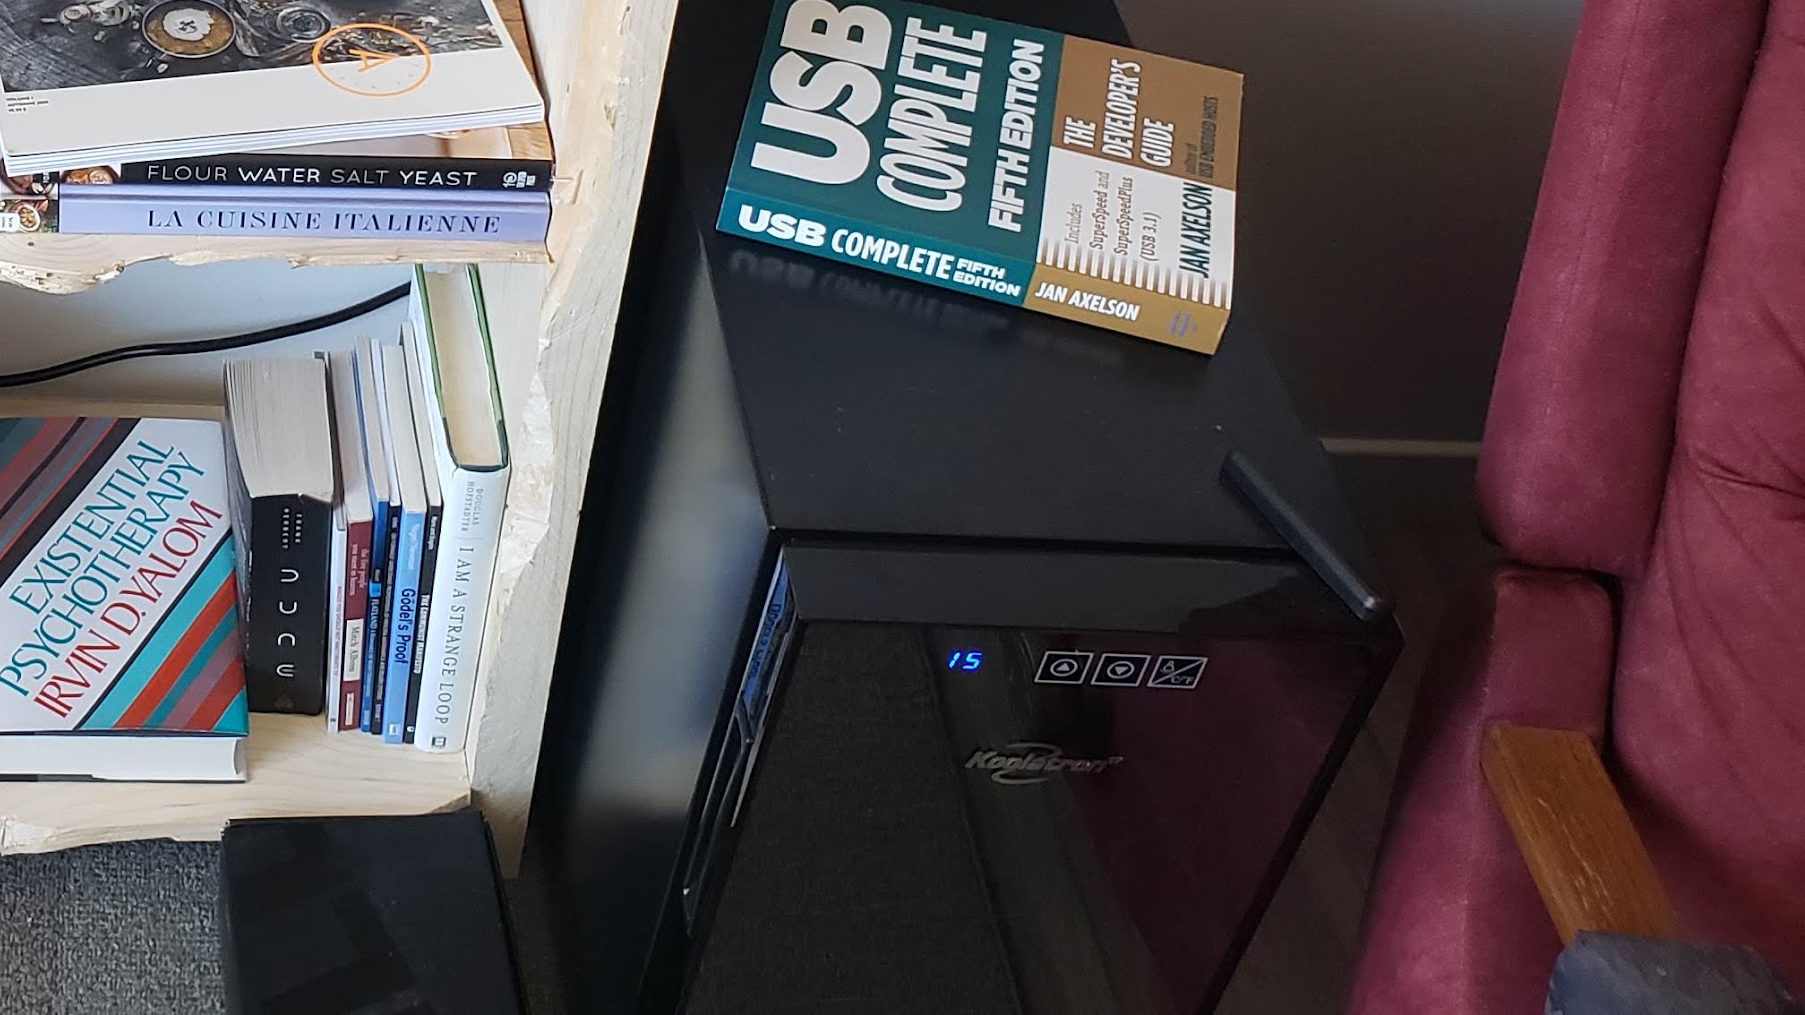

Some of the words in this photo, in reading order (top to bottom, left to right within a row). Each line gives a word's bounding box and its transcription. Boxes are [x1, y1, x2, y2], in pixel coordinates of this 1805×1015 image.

[999, 38, 1045, 150] EDITION
[1102, 57, 1142, 159] DEVELOPER'S
[1203, 96, 1219, 121] HOSTS
[876, 16, 988, 212] COMPLETE
[1063, 115, 1096, 149] THE
[1140, 117, 1175, 168] GUIDE
[147, 165, 227, 181] FLOUR
[238, 167, 321, 183] WATER
[330, 169, 390, 184] SALT
[399, 170, 478, 186] YEAST
[988, 148, 1030, 233] FIFTH
[1096, 171, 1110, 189] and
[148, 210, 185, 228] LA
[197, 210, 321, 230] CUISINE
[333, 213, 501, 233] ITALIENNE
[1064, 202, 1083, 245] Includes
[1089, 190, 1110, 250] SuperSpeed
[1113, 176, 1134, 257] SuperSpeedPlus
[1142, 211, 1162, 233] 3.1)
[1179, 182, 1213, 249] AXELSON
[738, 204, 828, 247] USB
[831, 228, 956, 280] COMPLETE
[1139, 235, 1158, 262] (USB
[953, 271, 1021, 297] EDITION
[957, 257, 1005, 279] FIFTH
[1179, 251, 1210, 279] JAN
[1034, 281, 1067, 304] JAN
[1067, 289, 1141, 322] AXELSON
[461, 481, 476, 533] HOFSTADTER
[472, 488, 484, 526] DOUGLAS
[8, 438, 175, 616] EXISTENTIAL
[119, 500, 223, 603] YALOM
[454, 558, 472, 582] AM
[396, 587, 415, 631] Gödel's
[420, 594, 430, 606] THE
[451, 588, 467, 599] A
[100, 602, 146, 636] D.
[369, 598, 379, 628] FLATLAND
[393, 633, 410, 664] Proof
[440, 604, 465, 677] STRANGE
[33, 629, 121, 719] IRVIN
[948, 651, 983, 671] 15
[434, 682, 454, 724] LOOP
[965, 750, 1107, 773] Koolatron
